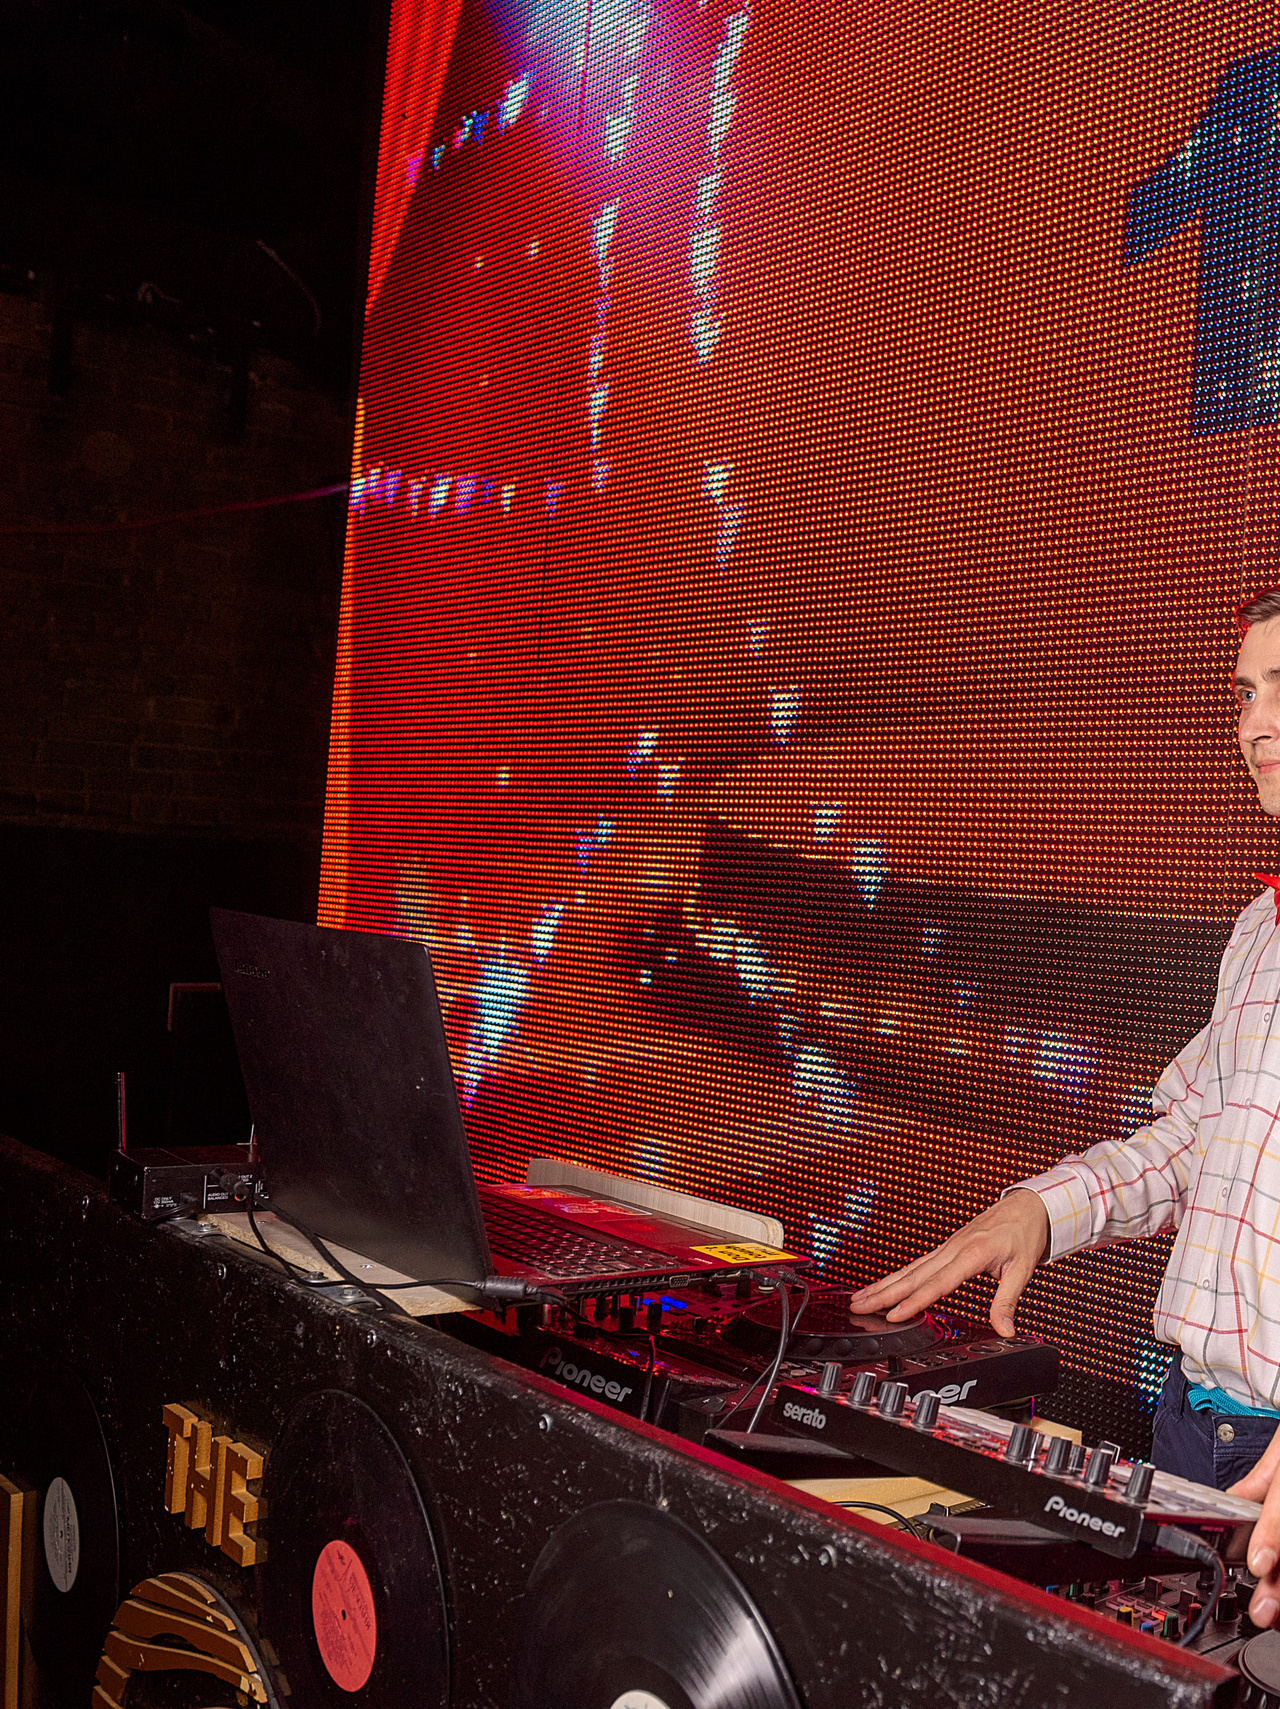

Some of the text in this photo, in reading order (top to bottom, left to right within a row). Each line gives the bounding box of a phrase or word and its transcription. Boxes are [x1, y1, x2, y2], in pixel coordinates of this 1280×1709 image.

[538, 1346, 633, 1402] Pioneer
[783, 1402, 827, 1430] serato
[162, 1402, 264, 1567] THE
[1043, 1495, 1126, 1538] Pioneer
